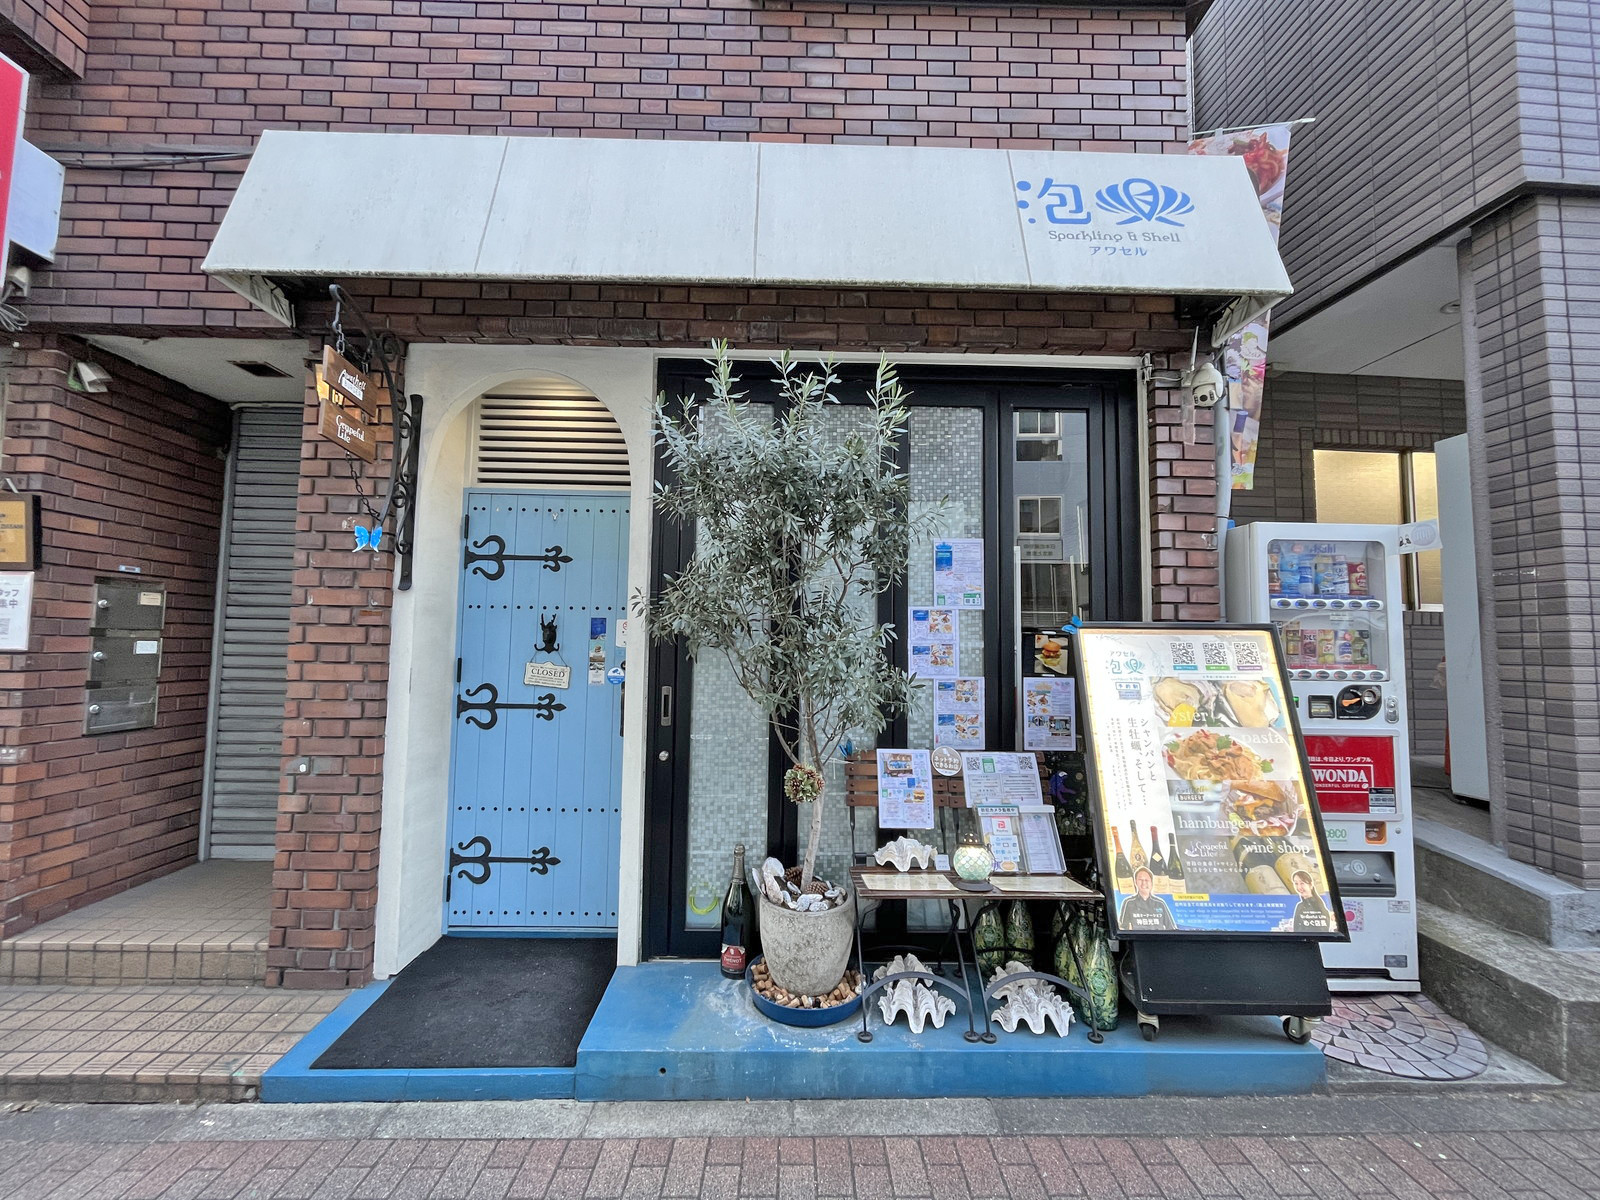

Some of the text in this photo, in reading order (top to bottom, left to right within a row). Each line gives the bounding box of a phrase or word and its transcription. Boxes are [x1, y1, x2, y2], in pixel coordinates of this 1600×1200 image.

[1016, 177, 1092, 225] 泡
[1048, 230, 1123, 244] Sparkling
[1142, 231, 1181, 243] Shell
[1089, 246, 1149, 257] アワセル
[531, 667, 566, 678] CLOSED
[1165, 709, 1209, 724] yster
[1139, 717, 1157, 782] シャンパンと
[1311, 768, 1369, 783] WONDA
[1177, 815, 1252, 833] hamburger
[1242, 840, 1310, 857] wine shop
